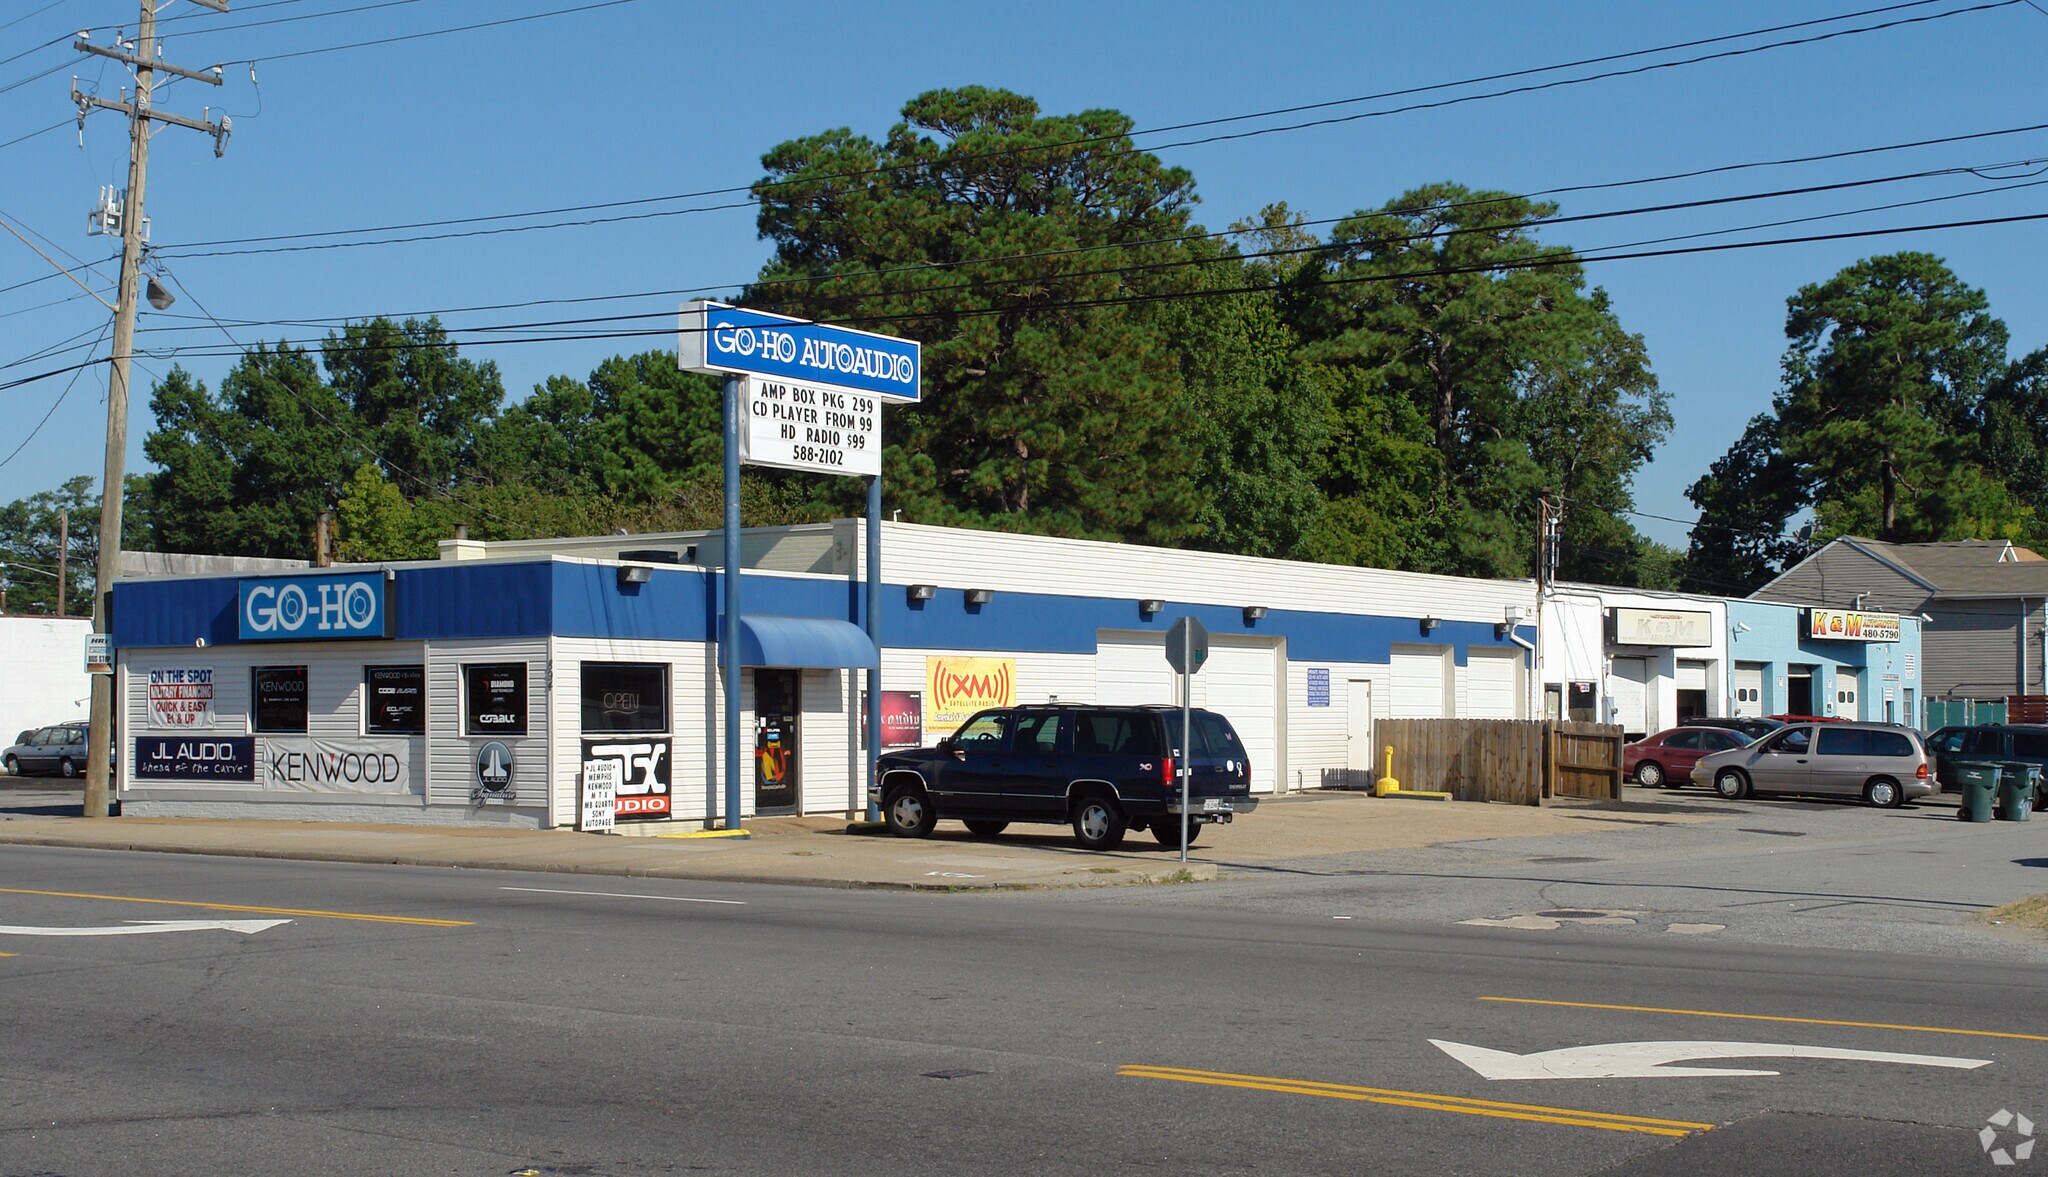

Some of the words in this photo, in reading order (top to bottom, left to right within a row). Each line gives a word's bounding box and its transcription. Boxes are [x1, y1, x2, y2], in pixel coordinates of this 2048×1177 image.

[714, 322, 796, 363] GO-HO
[761, 382, 786, 399] AMP
[793, 388, 816, 405] BOX
[822, 393, 845, 409] PKG
[852, 397, 873, 414] 299
[753, 401, 768, 416] CD
[772, 405, 818, 424] PLAYER
[825, 412, 855, 430] FROM
[859, 417, 873, 432] 99
[781, 424, 796, 440] HD
[806, 427, 841, 446] RADIO
[847, 433, 865, 449] $99
[793, 445, 843, 466] 588-2102
[246, 581, 376, 632] GO-HO
[1813, 612, 1828, 635] K
[1830, 616, 1843, 632] &
[1844, 613, 1862, 637] M
[1862, 629, 1899, 639] 480-5790
[150, 670, 164, 683] ON
[166, 670, 185, 683] THE
[188, 669, 213, 683] SPOT
[151, 686, 178, 698] MILITARY
[178, 685, 212, 698] FINANCING
[260, 681, 305, 692] KENWOOD
[156, 702, 178, 712] QUICK
[180, 701, 186, 712] &
[188, 701, 207, 712] EASY
[603, 692, 640, 709] OPEN
[177, 713, 182, 724] &
[185, 713, 195, 724] UP
[152, 743, 173, 760] JL
[176, 743, 233, 761] AUDIO
[142, 762, 170, 773] Ahead
[175, 762, 188, 772] of
[192, 762, 209, 773] the
[271, 753, 400, 783] KENWOOD
[588, 782, 612, 790] KENWOOD
[470, 785, 517, 808] Signature
[585, 819, 611, 828] AUTOPAGE
